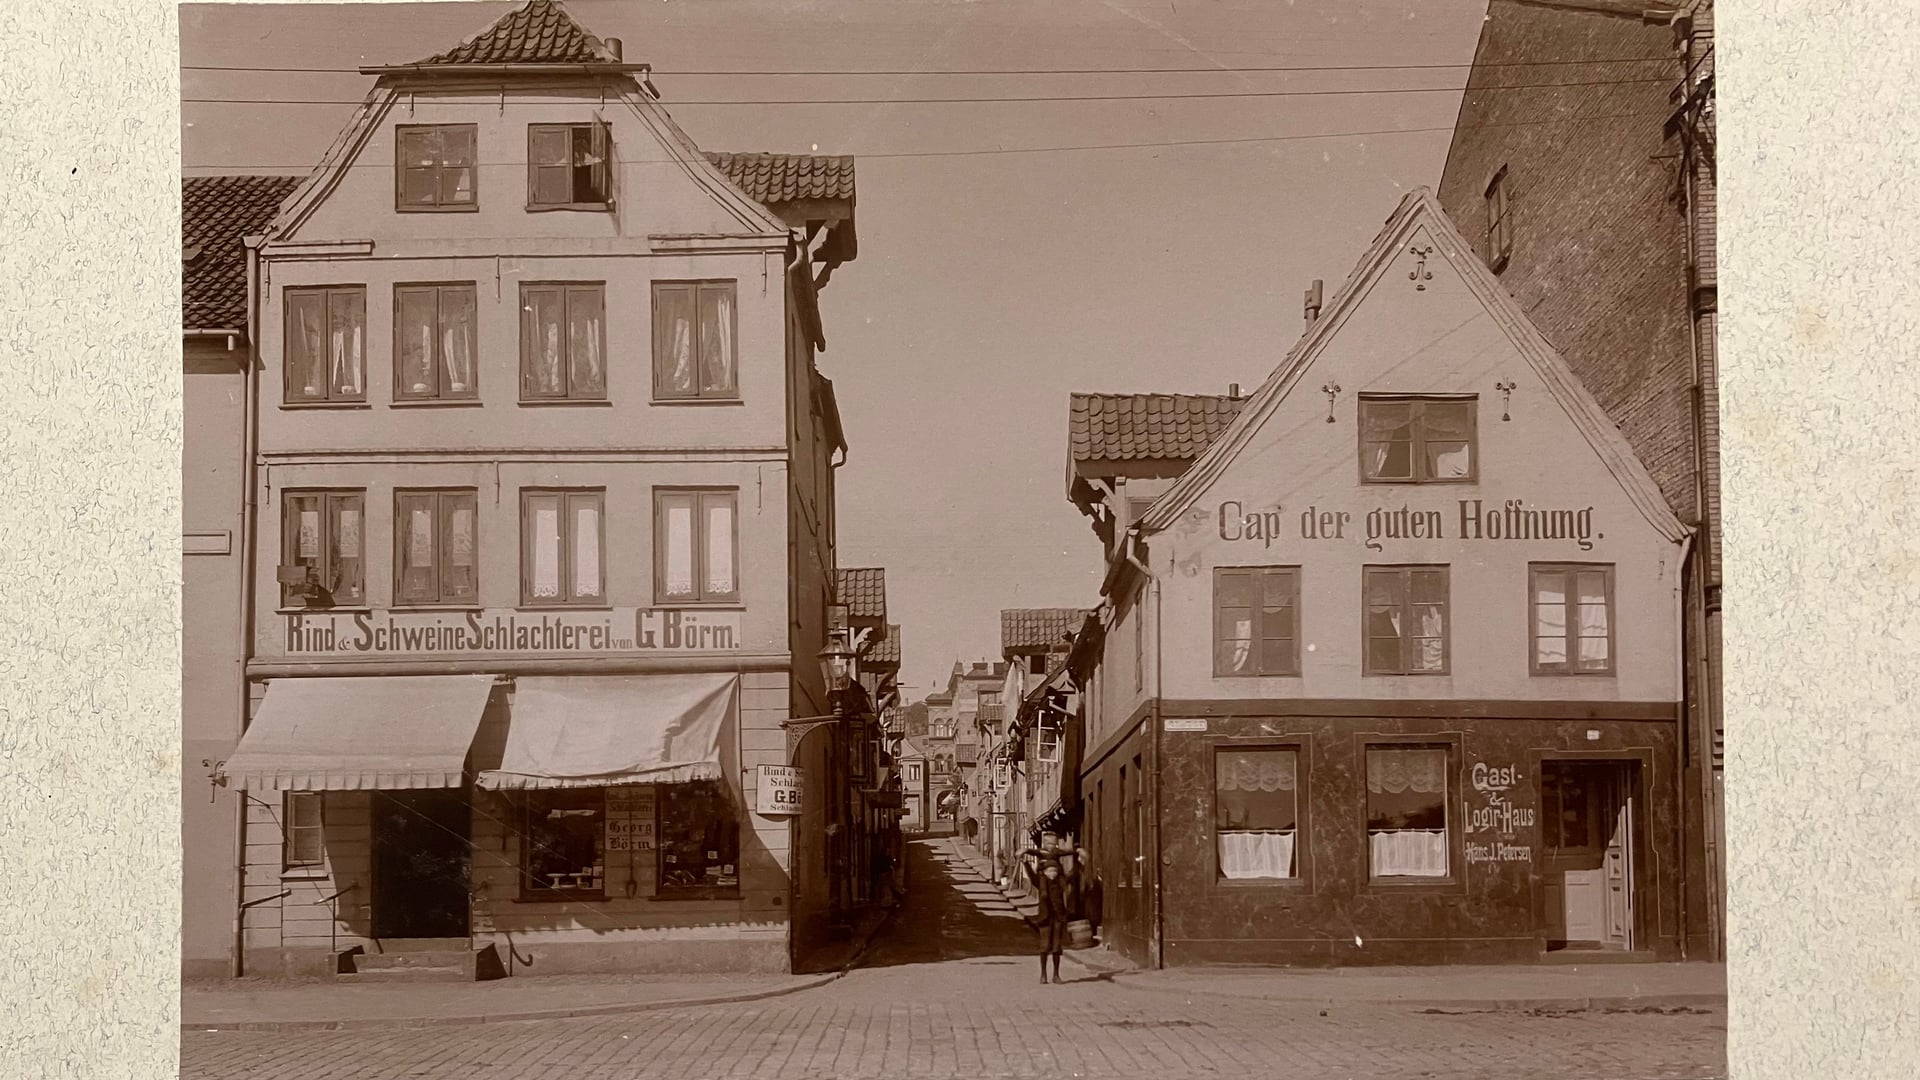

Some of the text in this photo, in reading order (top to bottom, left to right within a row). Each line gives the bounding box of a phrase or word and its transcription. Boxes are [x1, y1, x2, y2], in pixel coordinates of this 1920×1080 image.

[1218, 499, 1604, 552] Cap der guten Hoffnung.
[287, 612, 336, 652] Rind
[611, 637, 633, 649] von
[663, 608, 740, 649] Börm.
[609, 821, 652, 835] Georg
[1465, 841, 1489, 865] Hans
